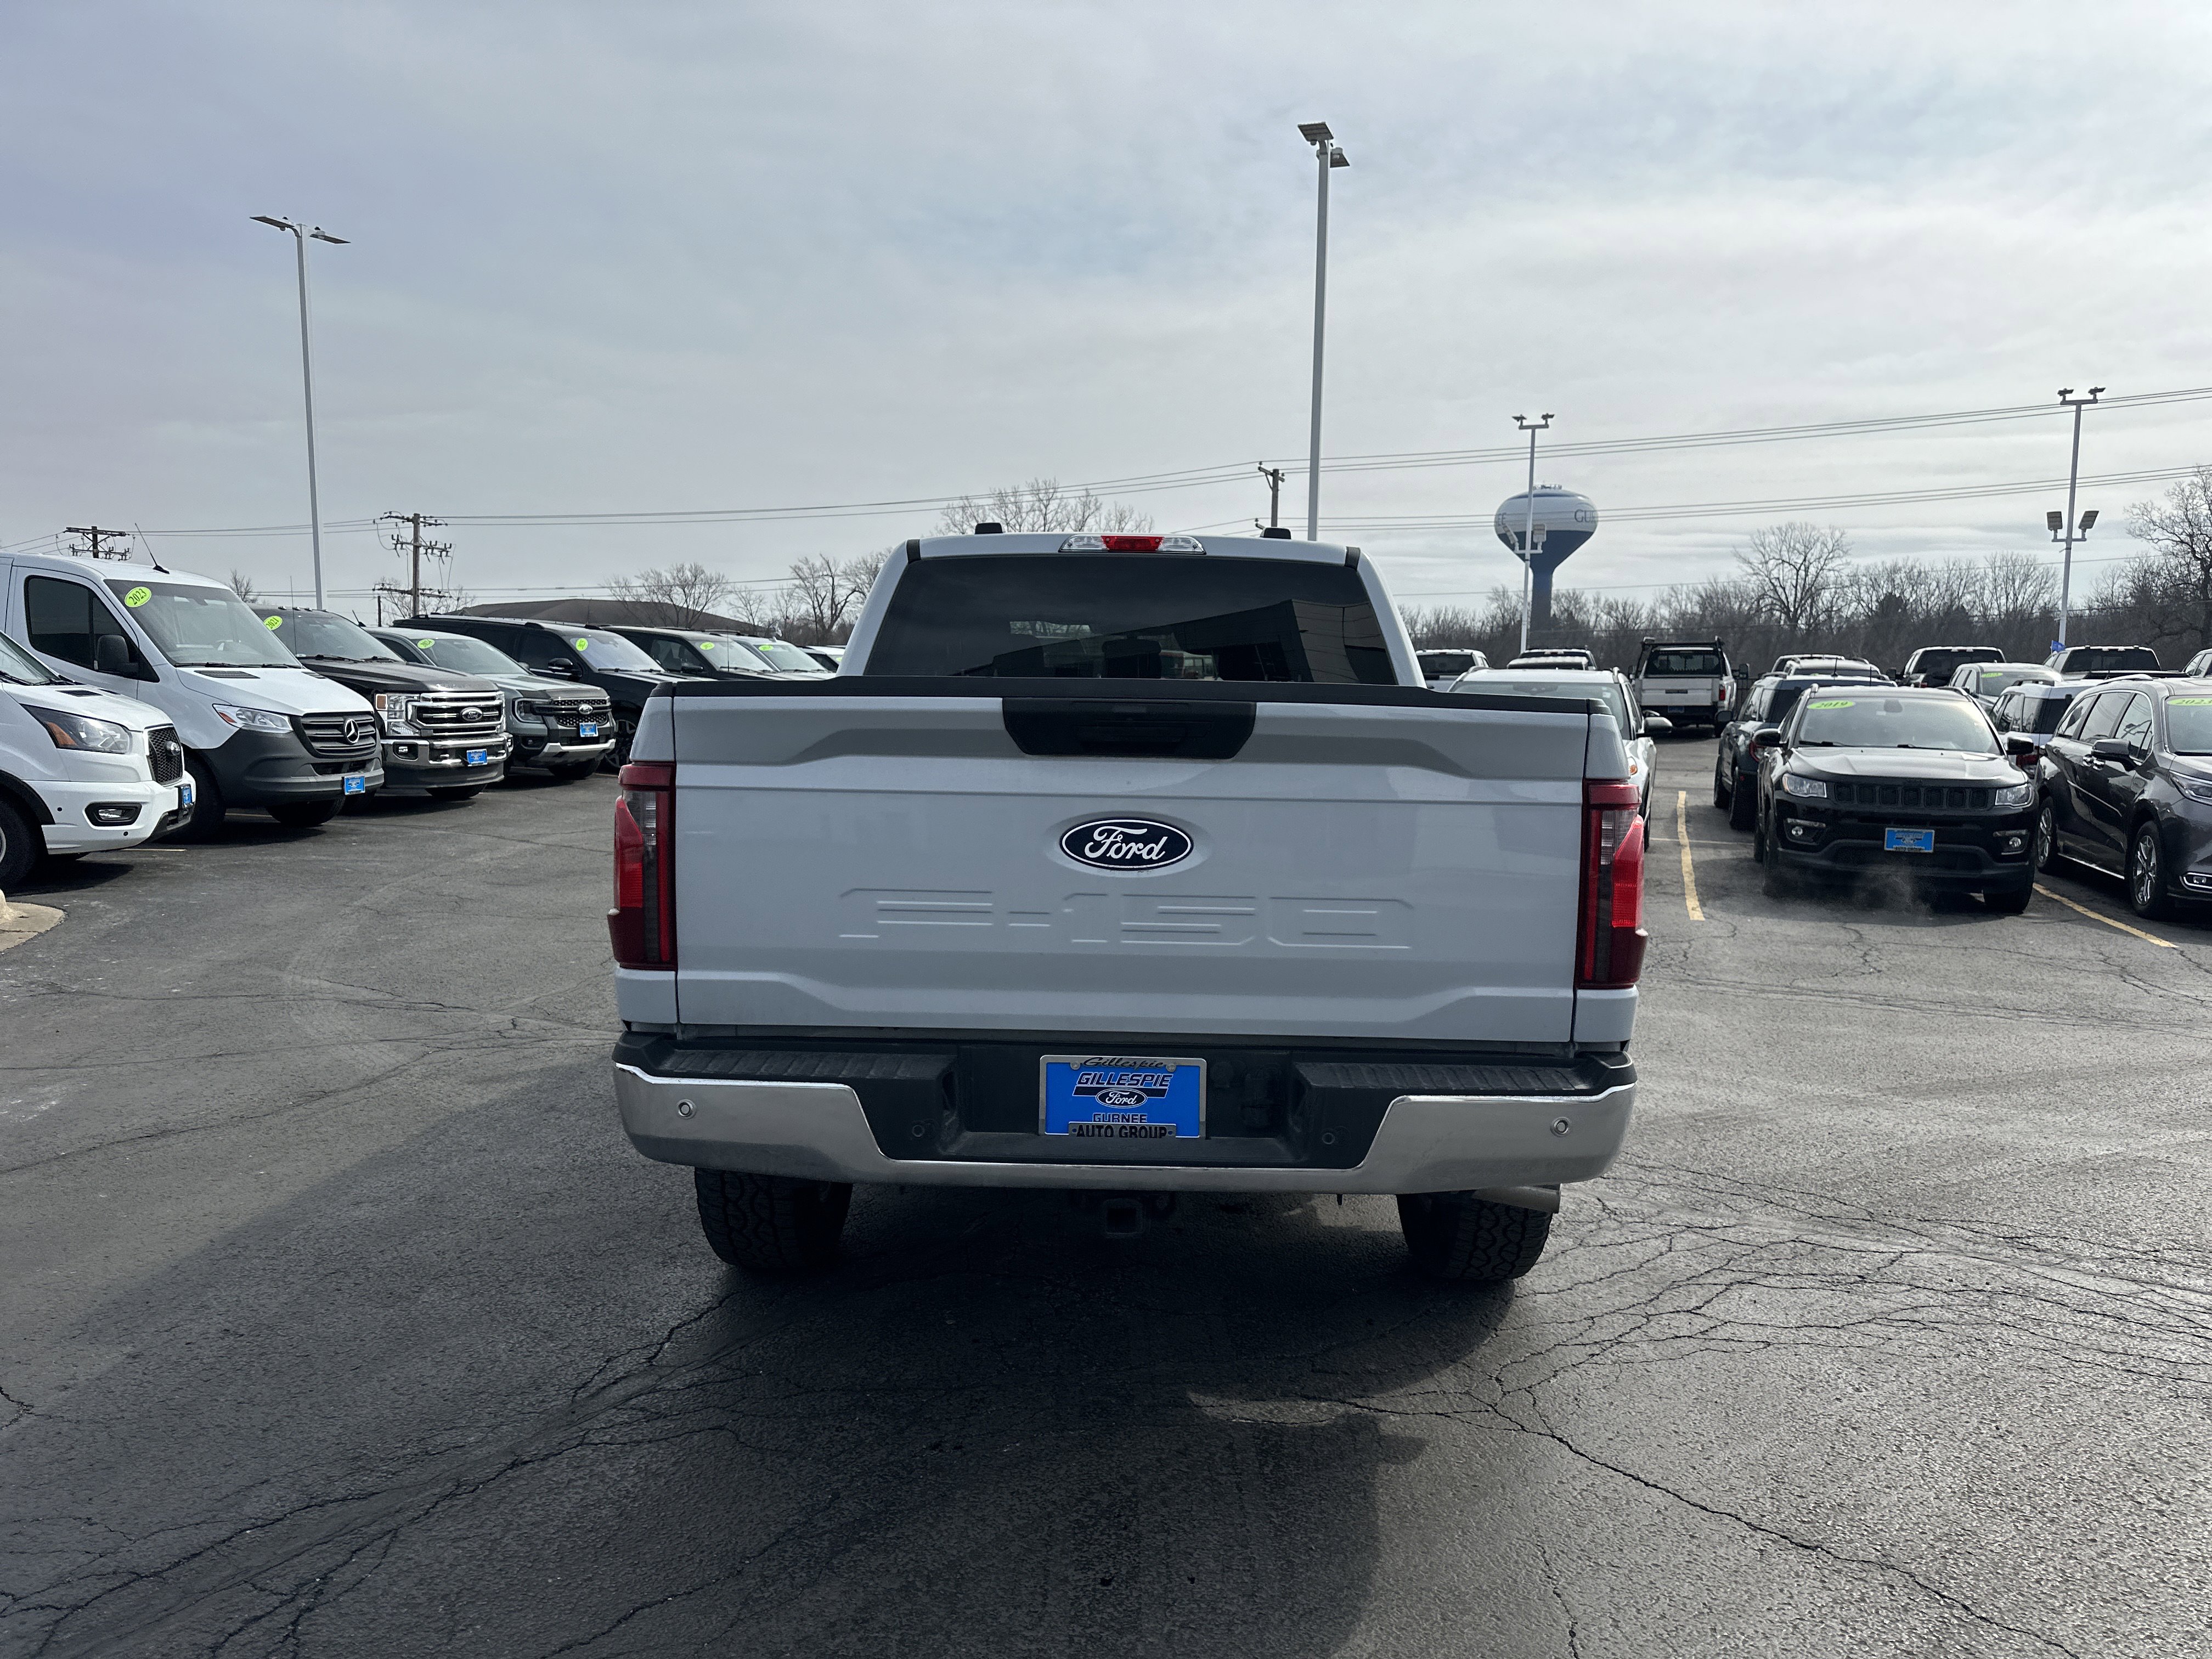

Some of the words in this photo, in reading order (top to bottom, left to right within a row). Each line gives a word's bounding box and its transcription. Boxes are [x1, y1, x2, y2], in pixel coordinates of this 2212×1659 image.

[128, 588, 147, 606] 2023
[266, 617, 279, 629] 2021
[1084, 826, 1168, 860] Ford
[839, 888, 1414, 950] F-150
[1083, 1057, 1164, 1070] Gillespie
[1077, 1071, 1173, 1088] GILLESPIE
[1105, 1089, 1137, 1104] Ford
[1092, 1113, 1148, 1123] GURNEE
[1076, 1124, 1114, 1137] AUTO
[1119, 1125, 1167, 1138] GROUP
